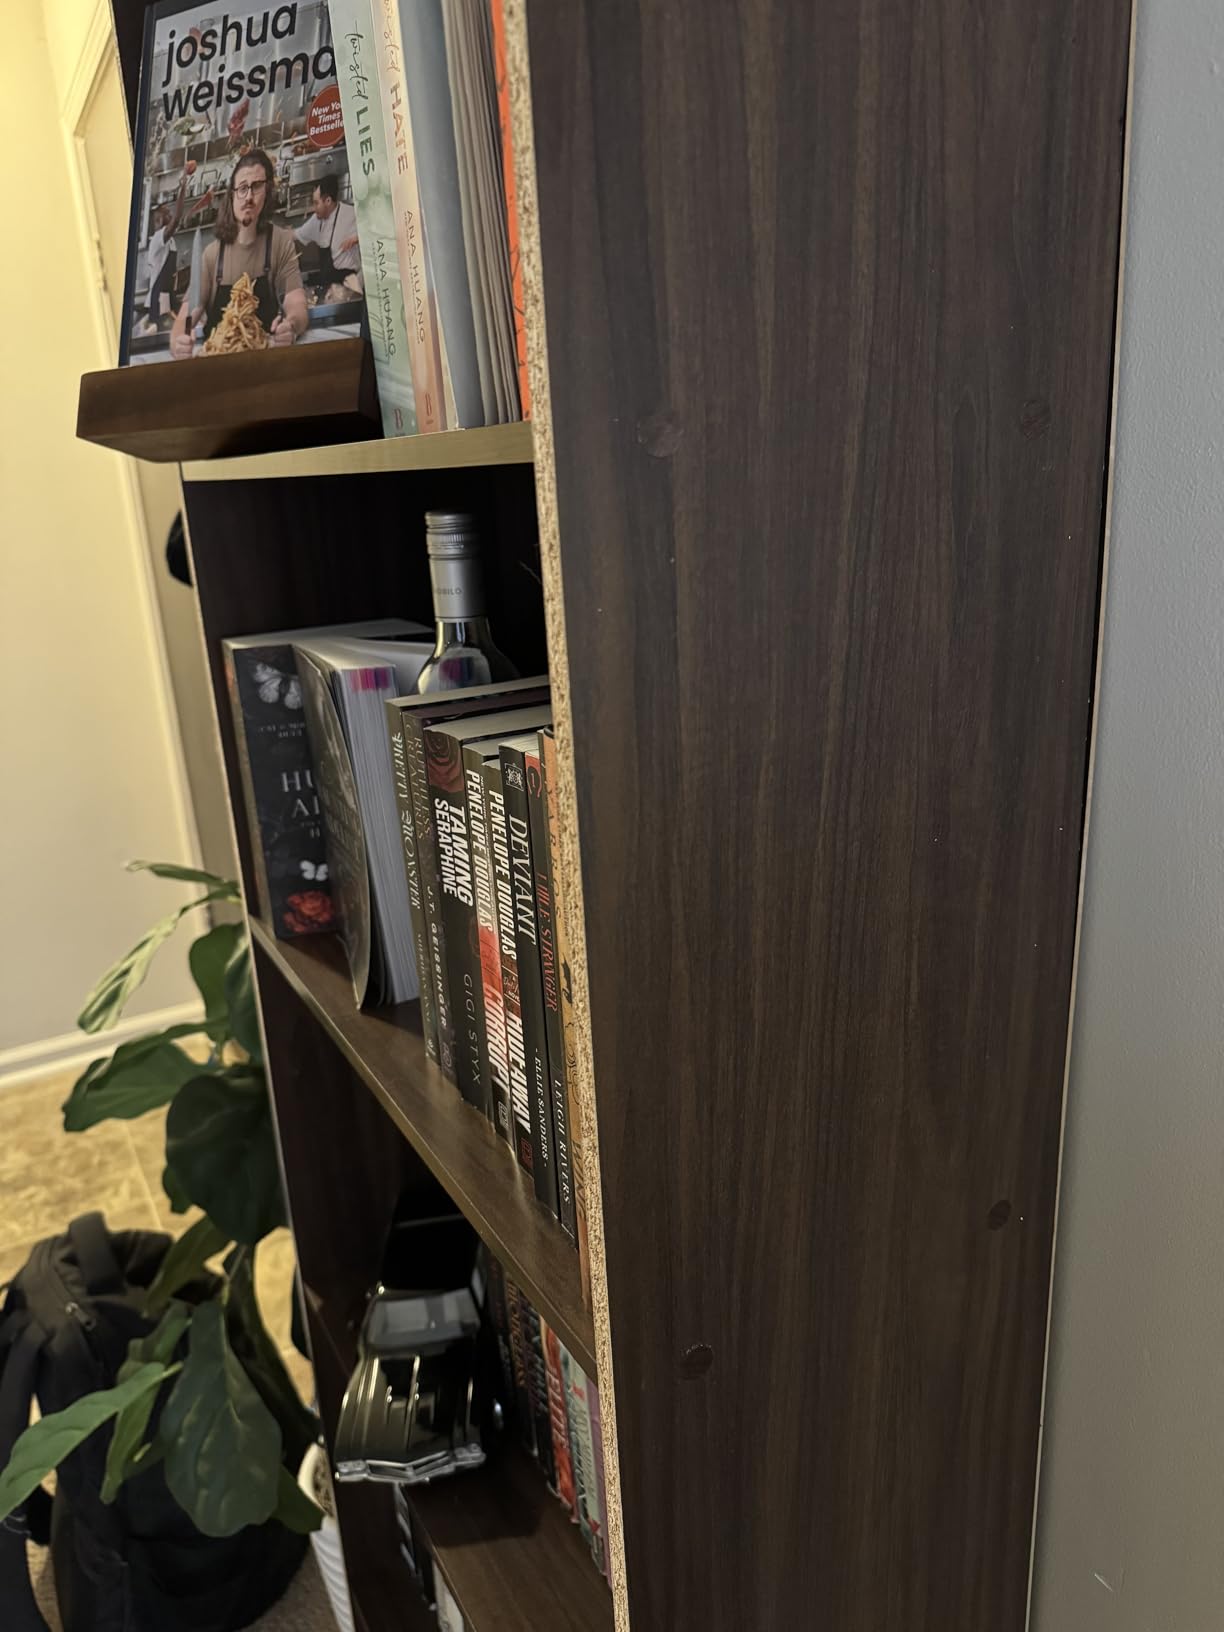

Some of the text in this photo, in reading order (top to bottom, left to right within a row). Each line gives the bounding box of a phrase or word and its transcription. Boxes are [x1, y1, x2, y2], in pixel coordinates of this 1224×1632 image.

[162, 3, 298, 88] joshua
[311, 104, 330, 117] New
[317, 111, 341, 126] Times
[356, 105, 375, 177] LIES
[389, 79, 409, 175] HATE
[376, 240, 388, 281] ANA
[382, 287, 397, 357] HUANG
[406, 210, 417, 257] ANA
[412, 265, 427, 344] HUANG
[391, 731, 409, 799] PRETTY
[405, 722, 425, 840] CREATURES
[414, 736, 432, 836] RUTHLESS
[465, 768, 489, 854] PENELOPE
[434, 797, 459, 899] SERAPHINE
[447, 803, 475, 908] TAMING
[488, 789, 511, 880] PENELOPE
[508, 813, 537, 946] DEVIANT
[473, 849, 494, 935] DOUGLAS
[496, 879, 517, 961] DOUGLAS
[430, 921, 448, 1031] GEISSINGER
[541, 926, 558, 1013] STRANGER
[463, 972, 482, 1086] GIGI STYX
[505, 1010, 532, 1136] HIDEAWAY
[534, 1055, 550, 1162] ELLIE SANDERS
[553, 1078, 571, 1205] LEIGH RIVERS
